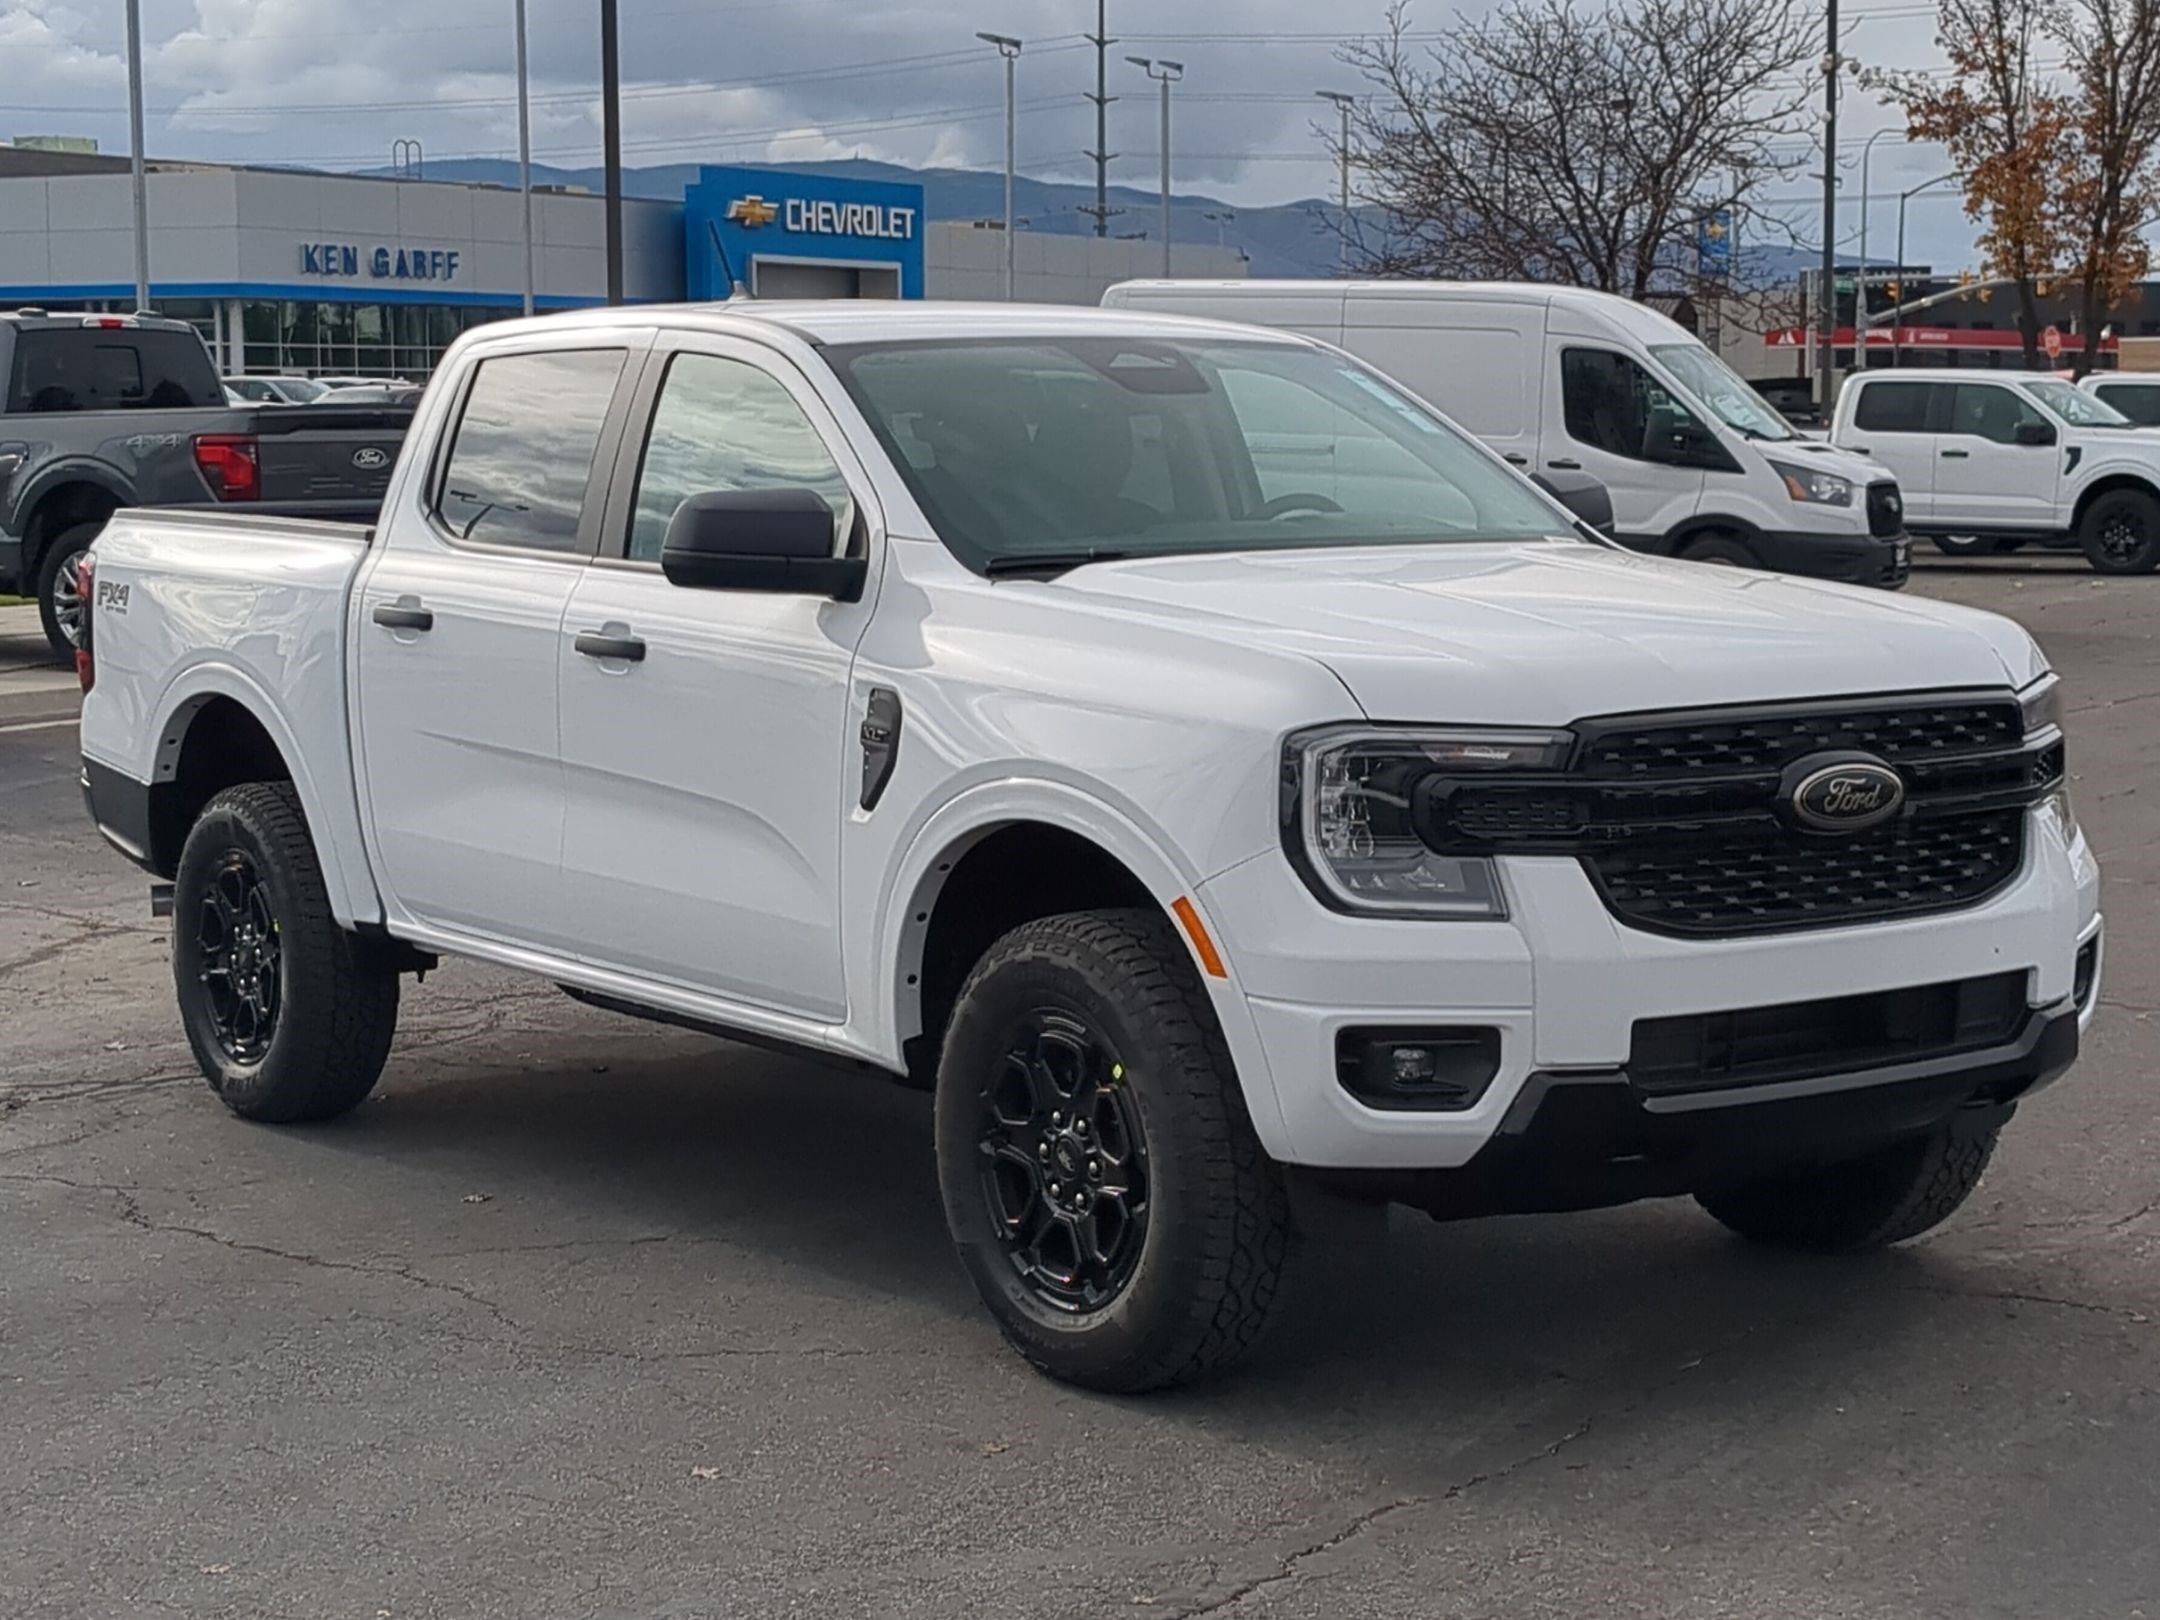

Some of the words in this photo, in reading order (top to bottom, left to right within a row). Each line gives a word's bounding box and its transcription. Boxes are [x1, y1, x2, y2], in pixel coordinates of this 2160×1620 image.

[785, 198, 915, 238] CHEVROLET
[303, 244, 358, 275] KEN
[372, 247, 459, 279] GARFF
[98, 581, 129, 606] FX4
[1824, 778, 1880, 811] Ford
